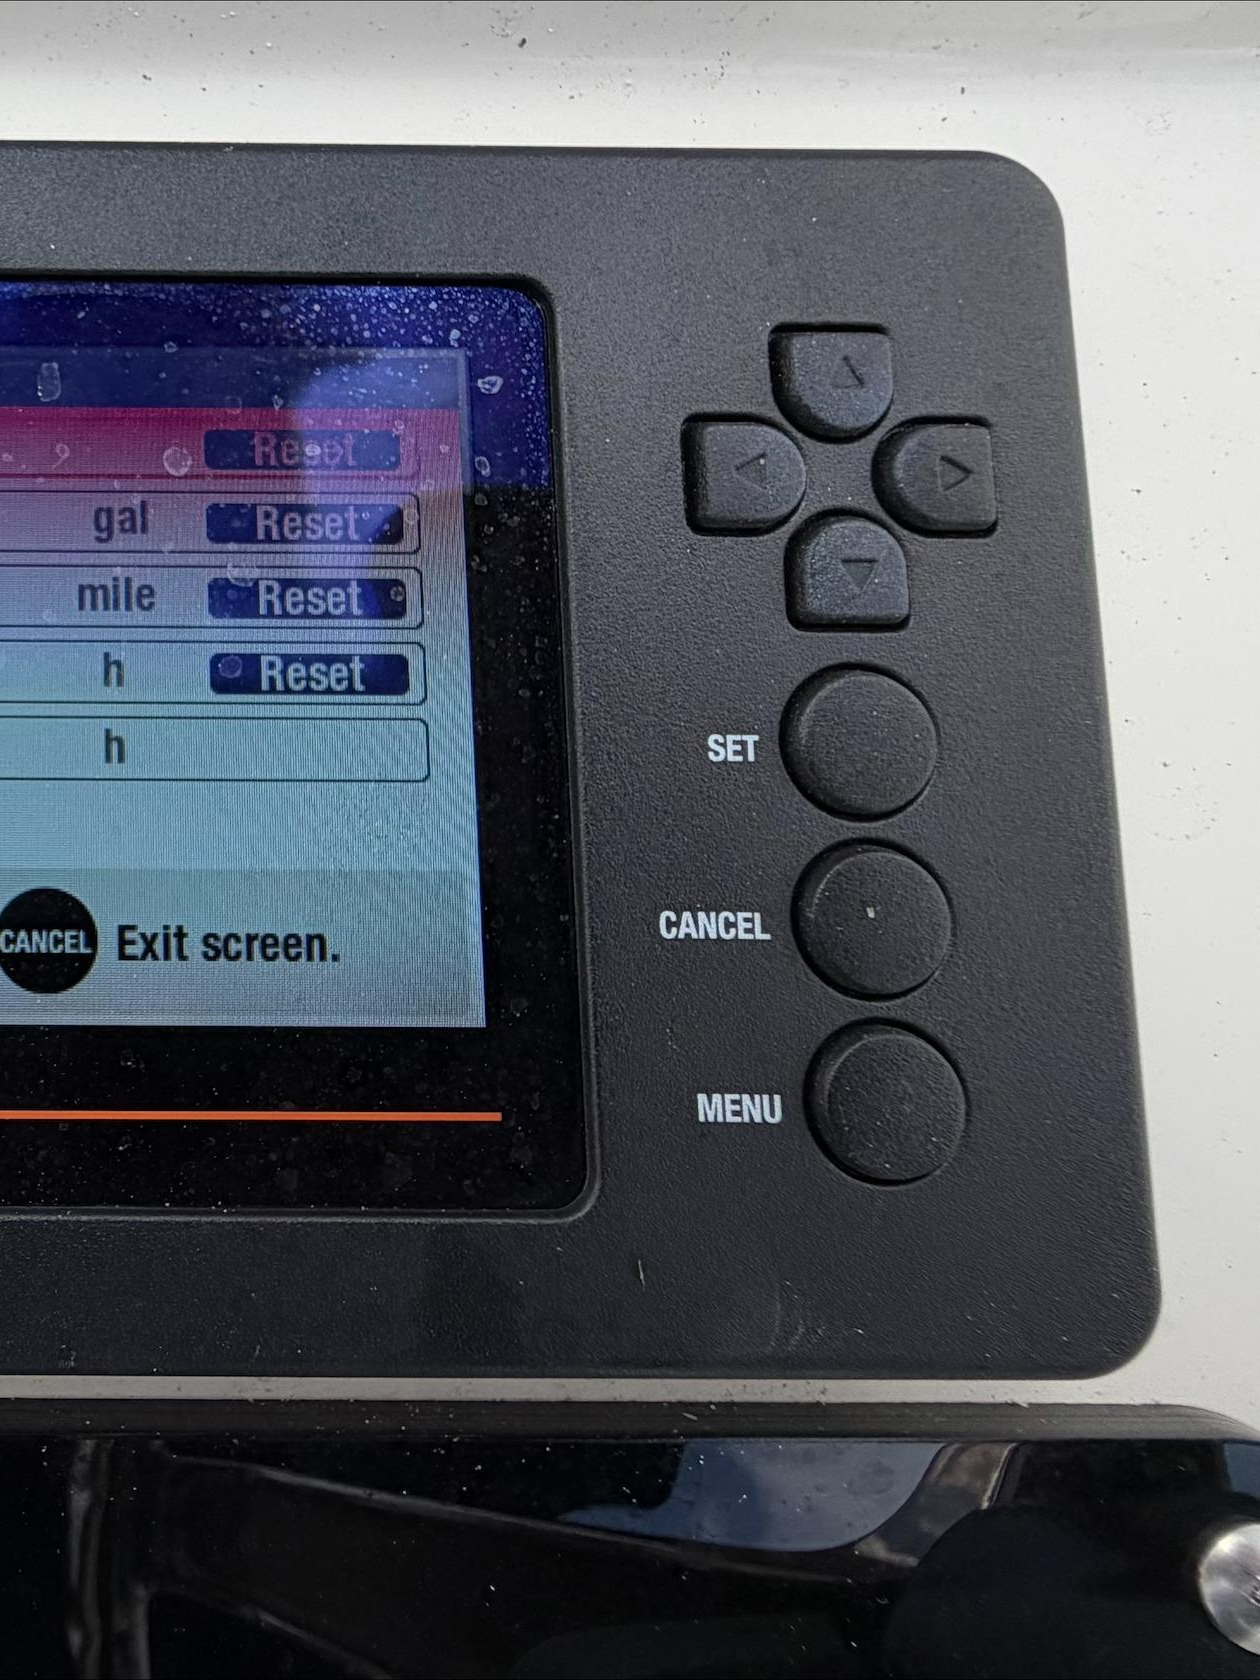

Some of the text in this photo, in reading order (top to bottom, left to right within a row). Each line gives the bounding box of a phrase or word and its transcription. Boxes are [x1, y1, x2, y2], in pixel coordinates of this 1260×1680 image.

[253, 431, 358, 466] Reset
[93, 501, 150, 542] gal
[256, 505, 362, 541] Reset
[77, 577, 156, 612] mile
[258, 580, 364, 616] Reset
[103, 652, 125, 687] h
[260, 655, 365, 692] Reset
[104, 728, 126, 764] h
[707, 733, 760, 762] SET
[659, 910, 772, 941] CANCEL
[117, 924, 340, 963] Exit screen.
[697, 1093, 783, 1124] MENU
